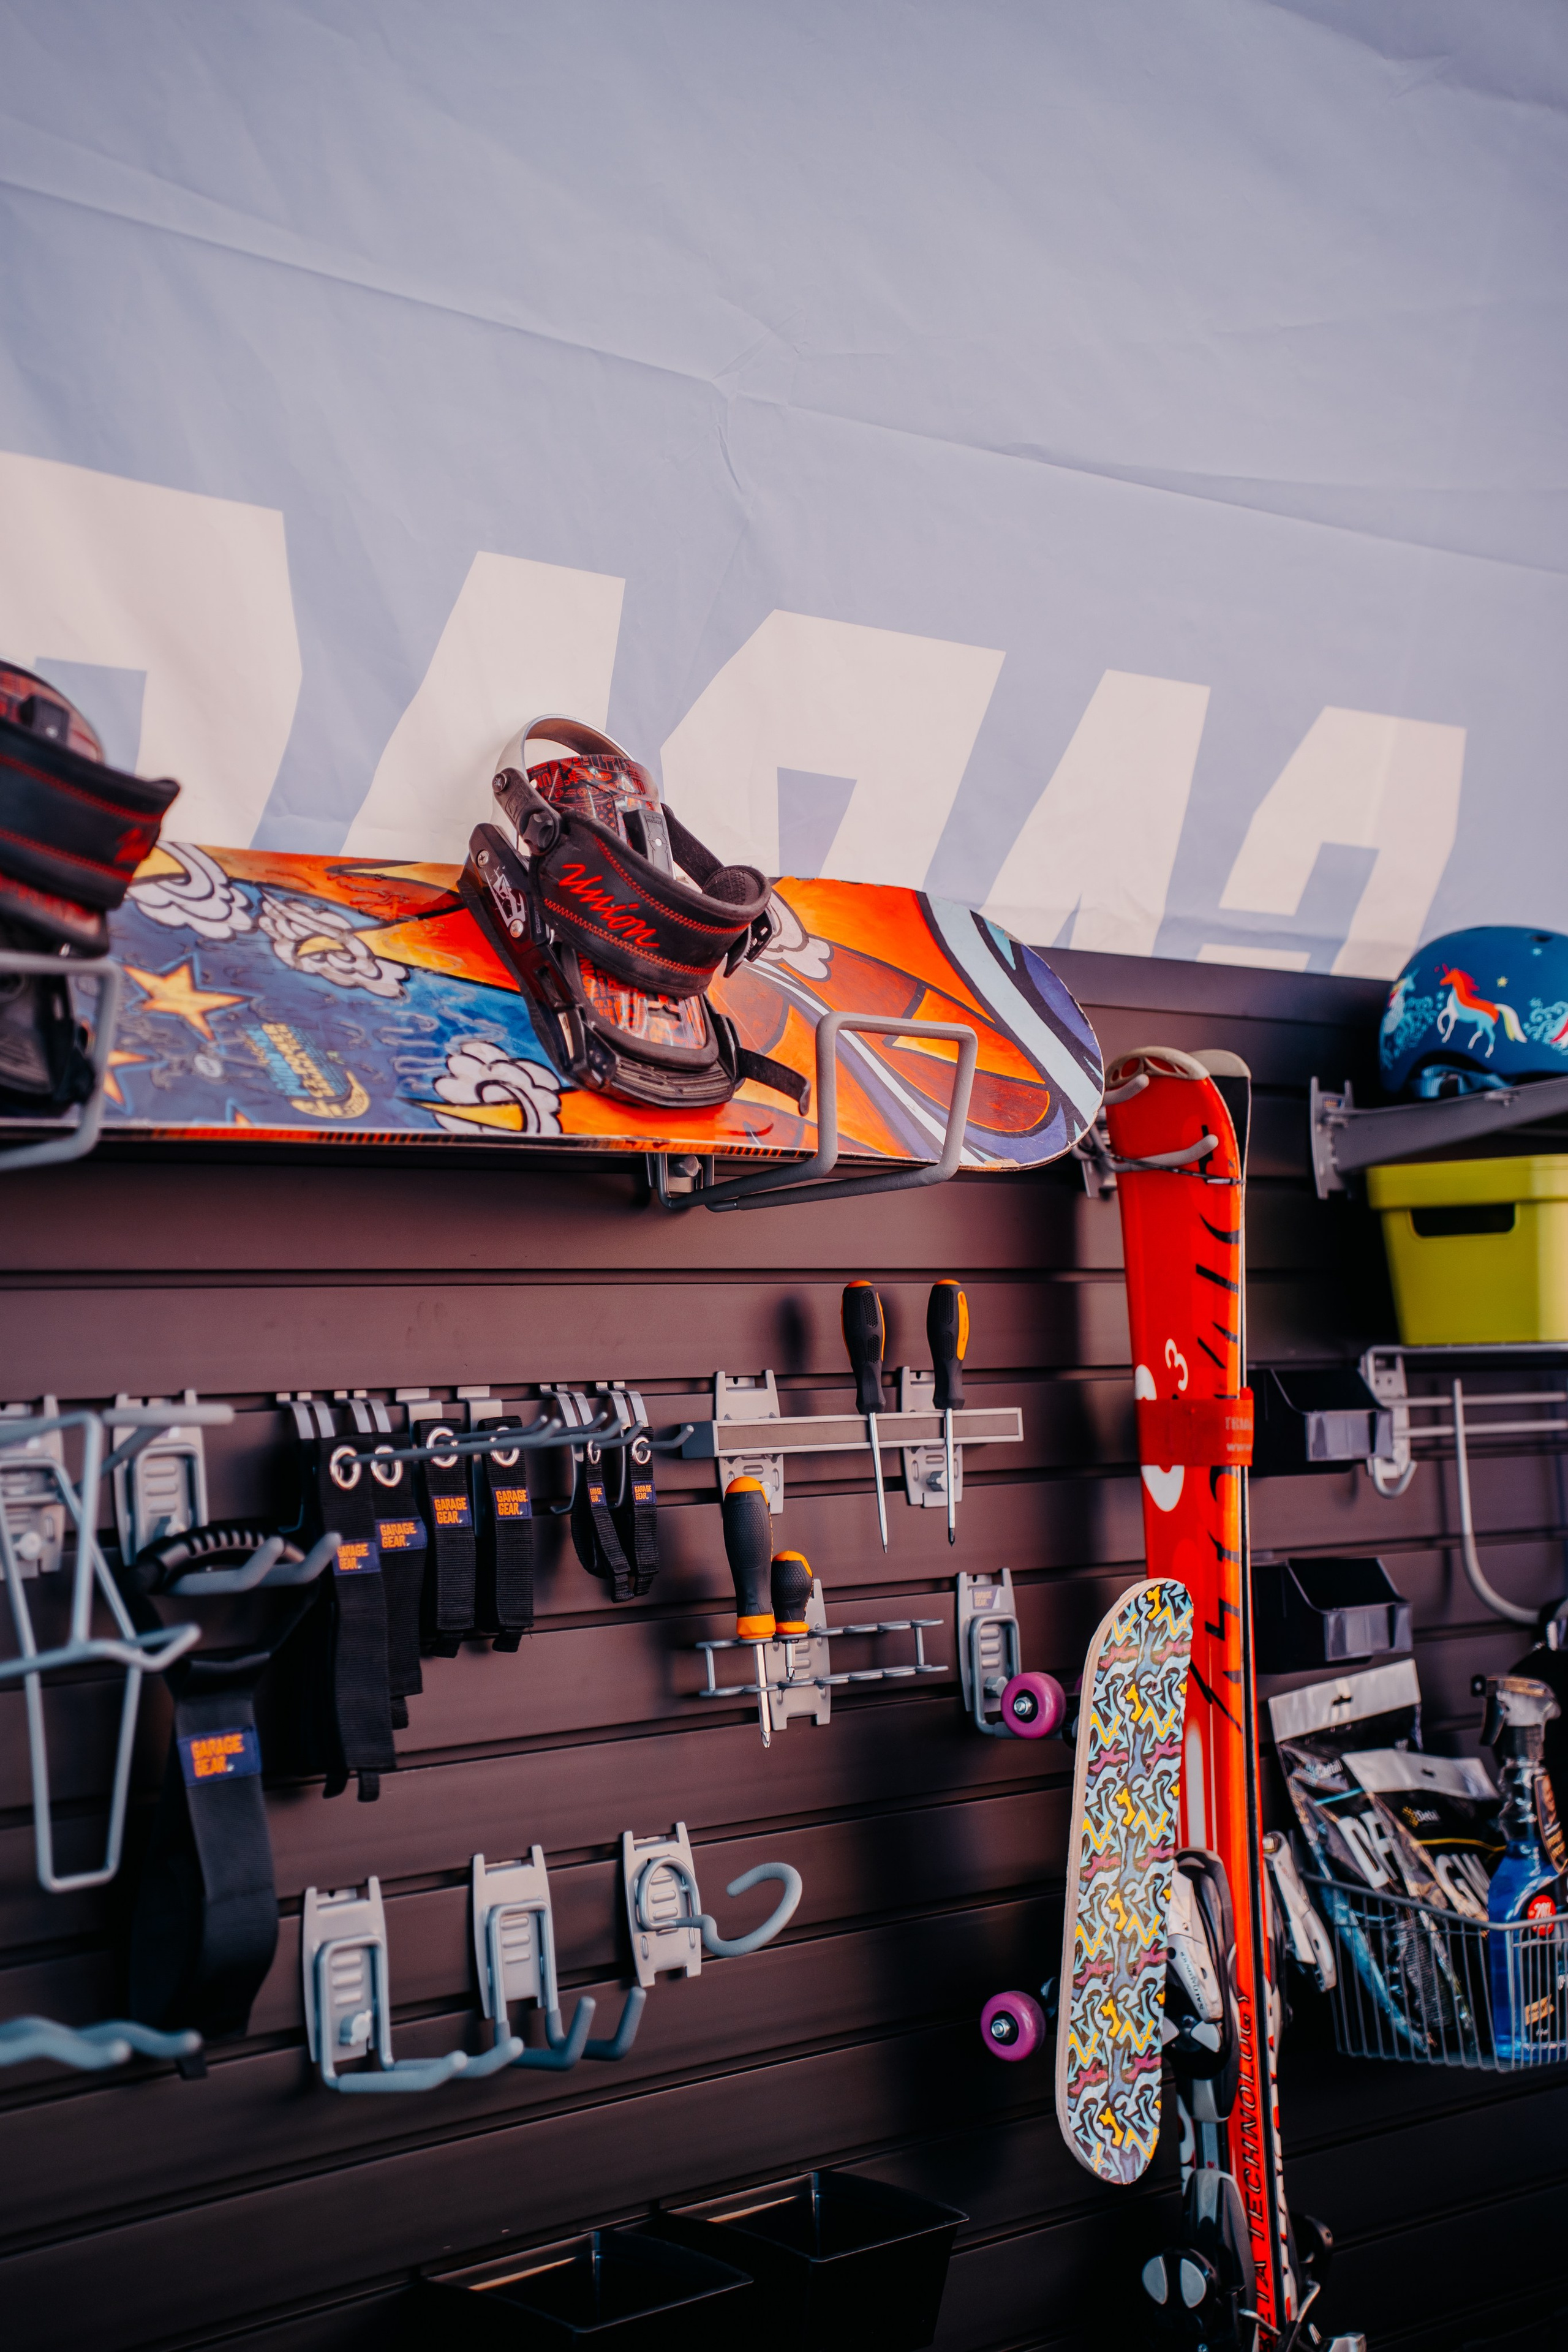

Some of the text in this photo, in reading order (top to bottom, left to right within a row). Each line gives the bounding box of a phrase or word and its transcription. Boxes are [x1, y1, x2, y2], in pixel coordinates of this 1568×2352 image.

[434, 1496, 467, 1511] GARAGE
[496, 1489, 528, 1503] GARAGE
[380, 1521, 417, 1536] GARAGE
[1237, 1992, 1265, 2242] TECHNOLOGY
